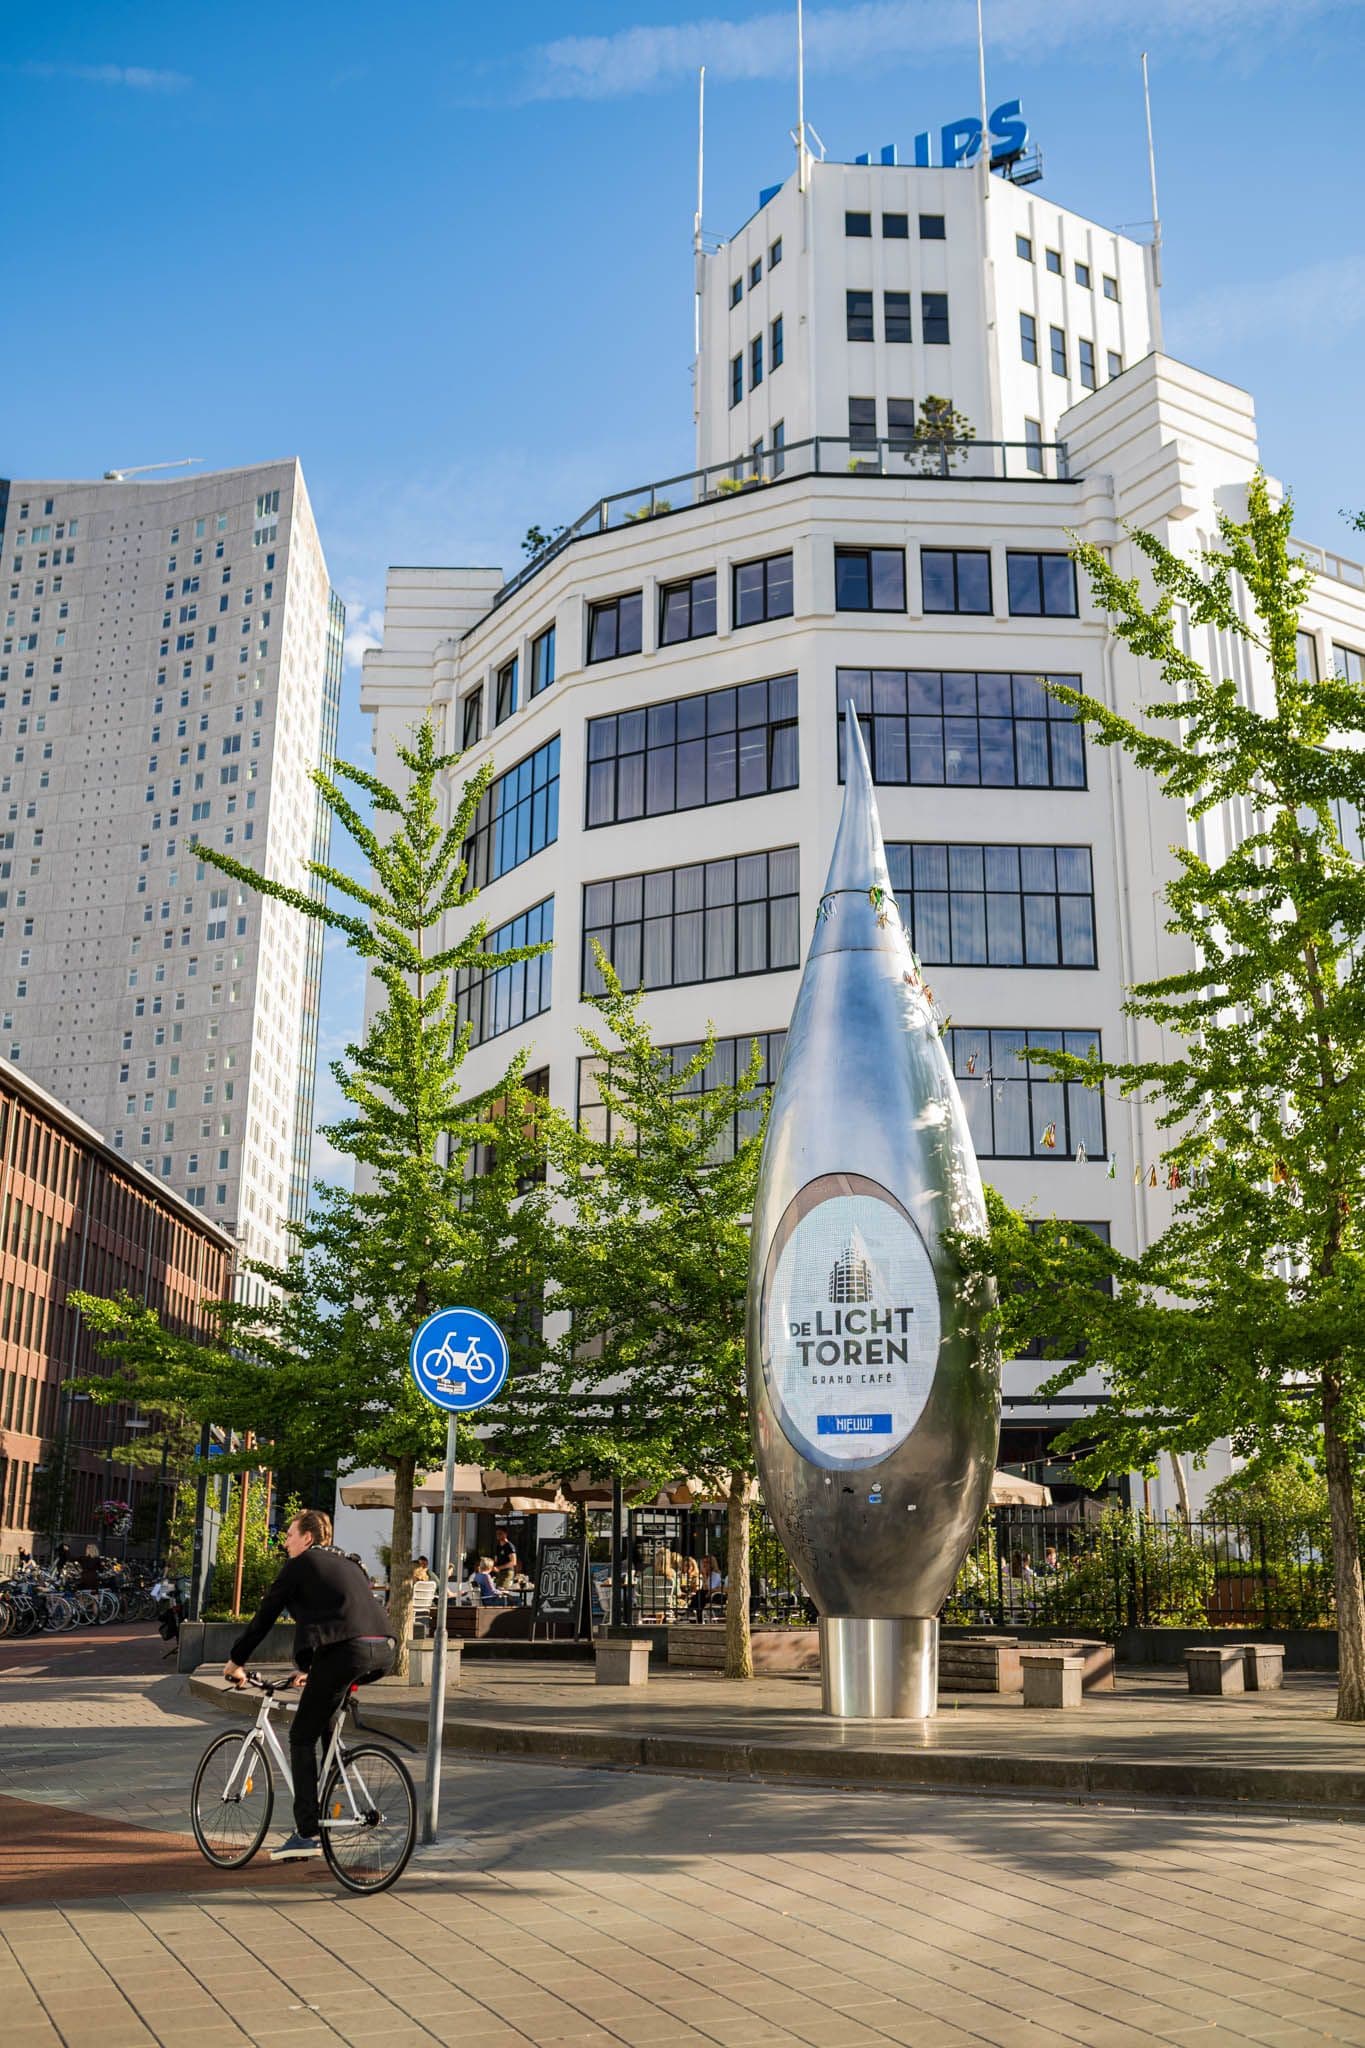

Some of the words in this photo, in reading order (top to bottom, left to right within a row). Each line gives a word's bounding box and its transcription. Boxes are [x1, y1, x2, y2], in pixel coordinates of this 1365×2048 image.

[789, 1322, 811, 1337] DE
[816, 1307, 914, 1336] LICHT
[796, 1338, 909, 1366] TOREN
[812, 1375, 852, 1384] GRAND
[861, 1372, 892, 1384] CAFÉ
[836, 1418, 873, 1432] NIEUW!
[547, 1550, 561, 1564] WE
[560, 1558, 577, 1571] ARE
[541, 1570, 578, 1597] OPEN
